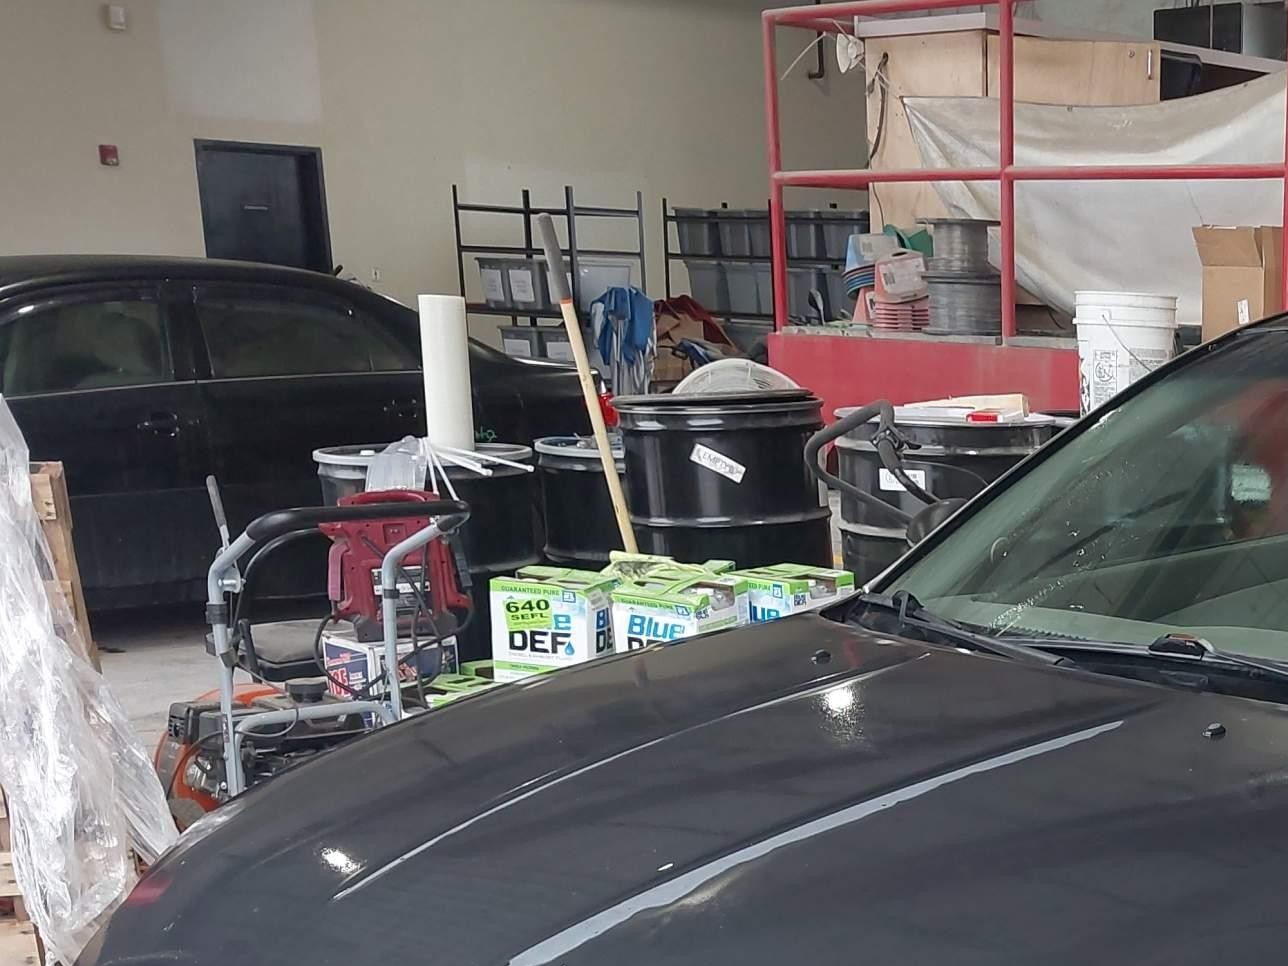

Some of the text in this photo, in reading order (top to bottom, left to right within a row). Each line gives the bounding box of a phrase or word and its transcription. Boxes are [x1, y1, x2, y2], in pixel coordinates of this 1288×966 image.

[501, 585, 541, 595] GUARANTEED
[505, 599, 550, 613] 640
[511, 612, 550, 621] SEFL
[627, 614, 685, 640] Blue
[509, 630, 572, 654] DEF
